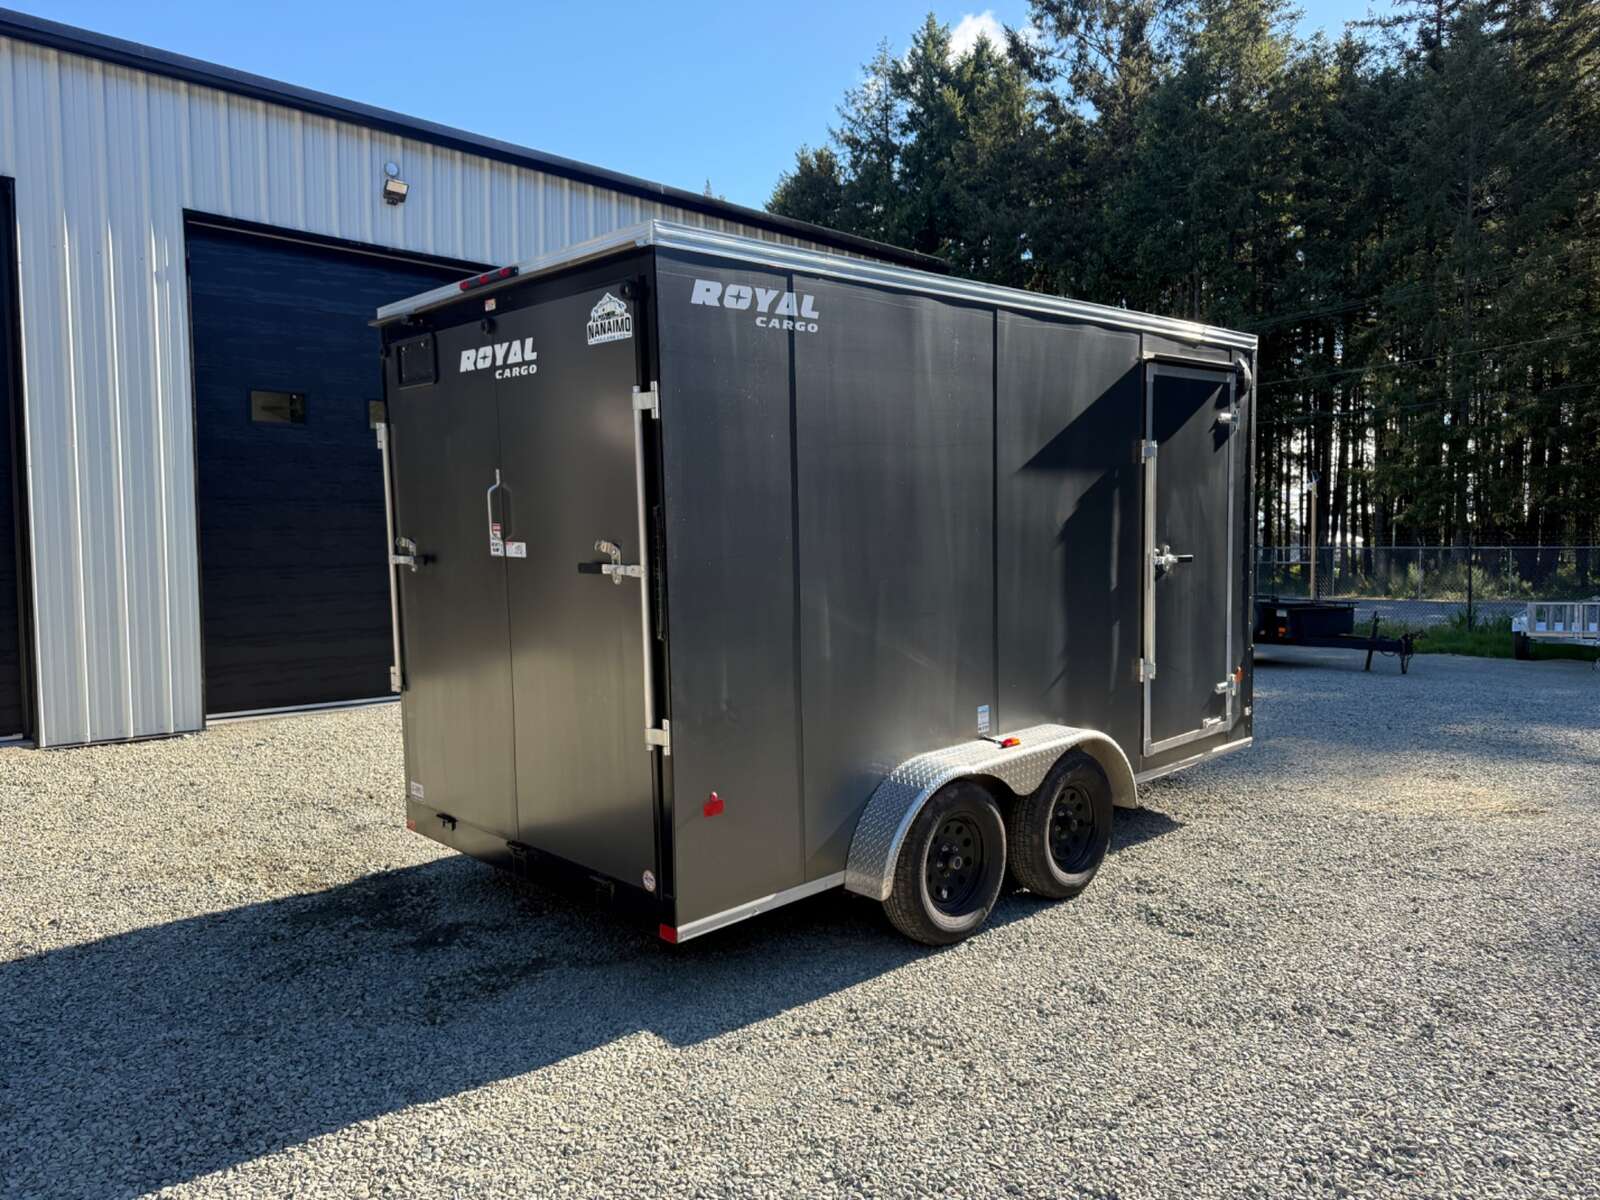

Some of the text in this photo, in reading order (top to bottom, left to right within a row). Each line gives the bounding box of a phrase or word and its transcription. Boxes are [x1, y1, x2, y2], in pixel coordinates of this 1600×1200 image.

[691, 279, 819, 319] ROYAL
[588, 316, 631, 340] NANAIMO
[755, 317, 818, 333] CARGO
[460, 337, 537, 373] ROYAL
[495, 364, 537, 379] CARGO
